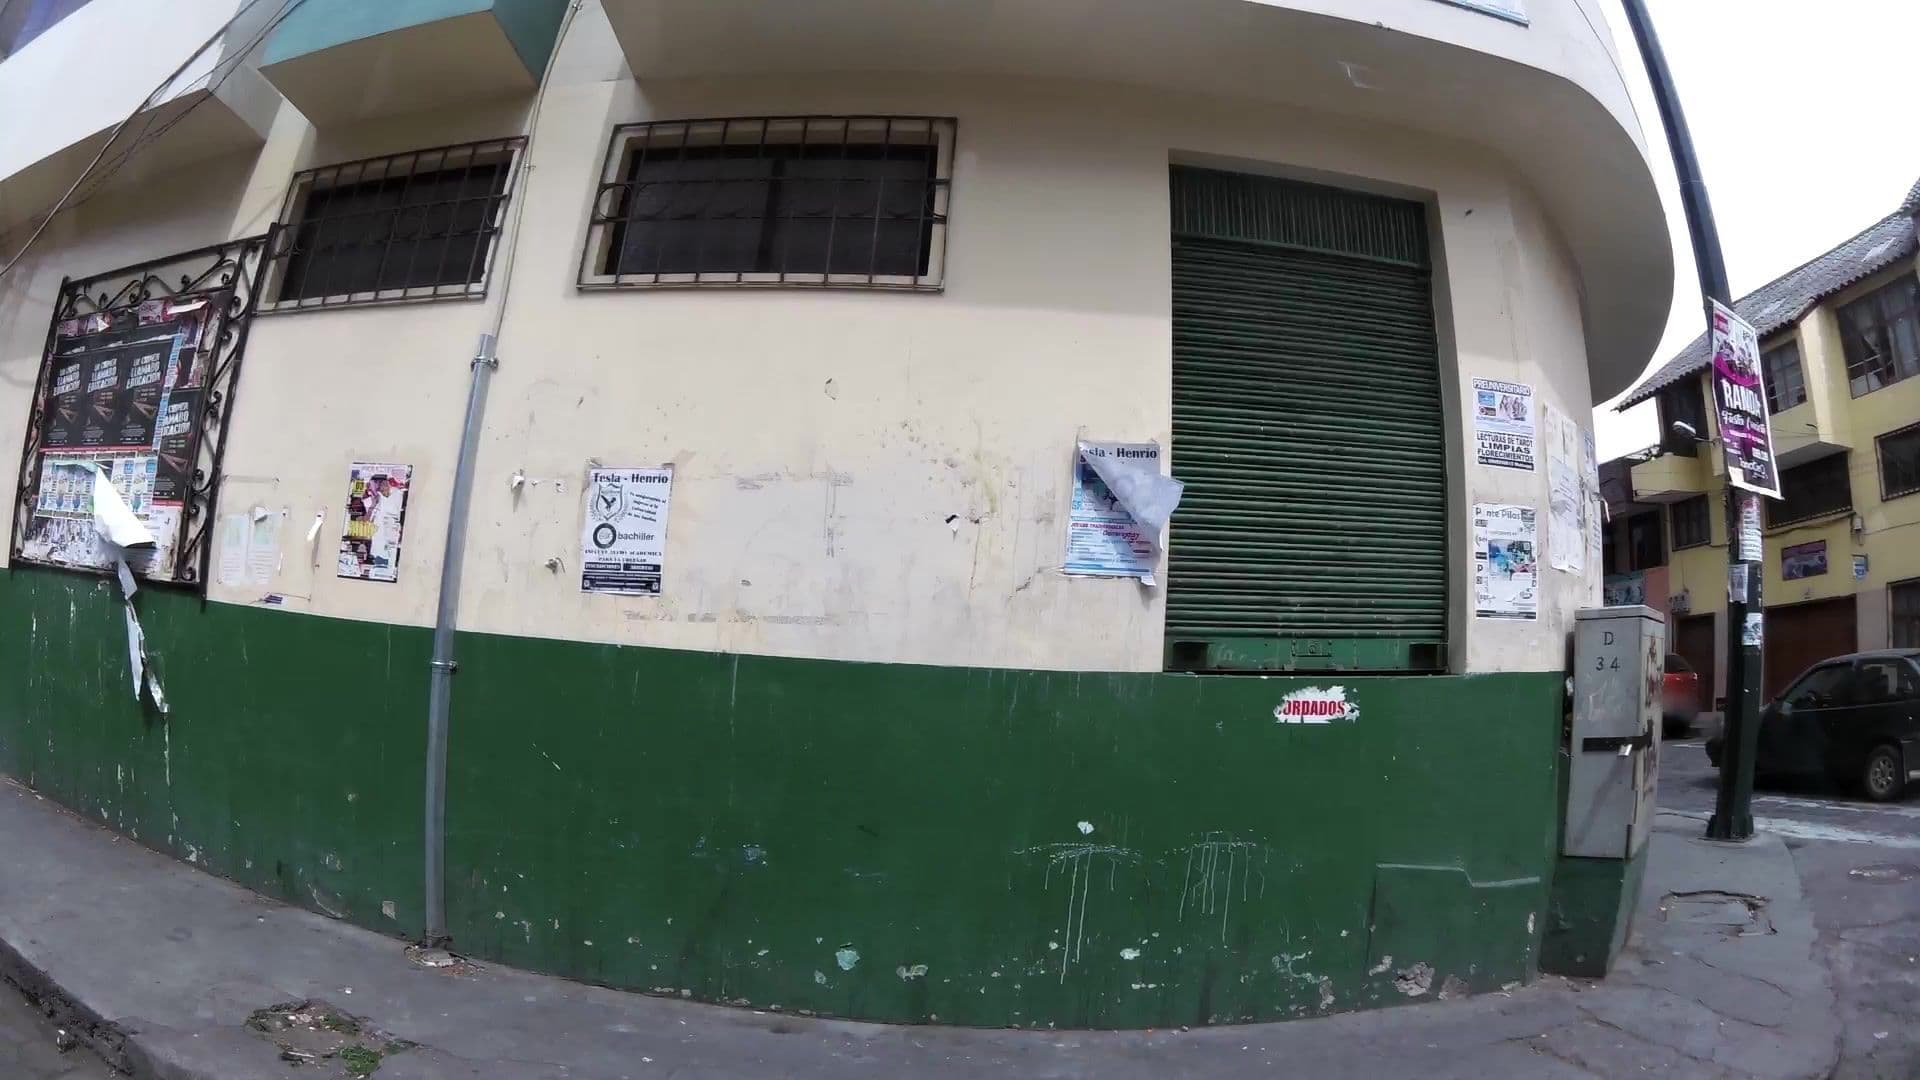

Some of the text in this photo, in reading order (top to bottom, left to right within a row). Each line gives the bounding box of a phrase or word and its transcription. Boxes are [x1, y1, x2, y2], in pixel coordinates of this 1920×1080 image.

[1477, 433, 1533, 447] LECTURAS DE TAROT
[1117, 448, 1157, 458] Henrio
[1482, 441, 1530, 454] LIMPIAS
[1478, 448, 1534, 462] FLORECIMIENTOS
[594, 472, 621, 483] Tesla
[631, 473, 669, 484] Henrio
[618, 531, 655, 541] bachiller
[1603, 632, 1614, 646] D
[1281, 700, 1346, 715] ORDADOS
